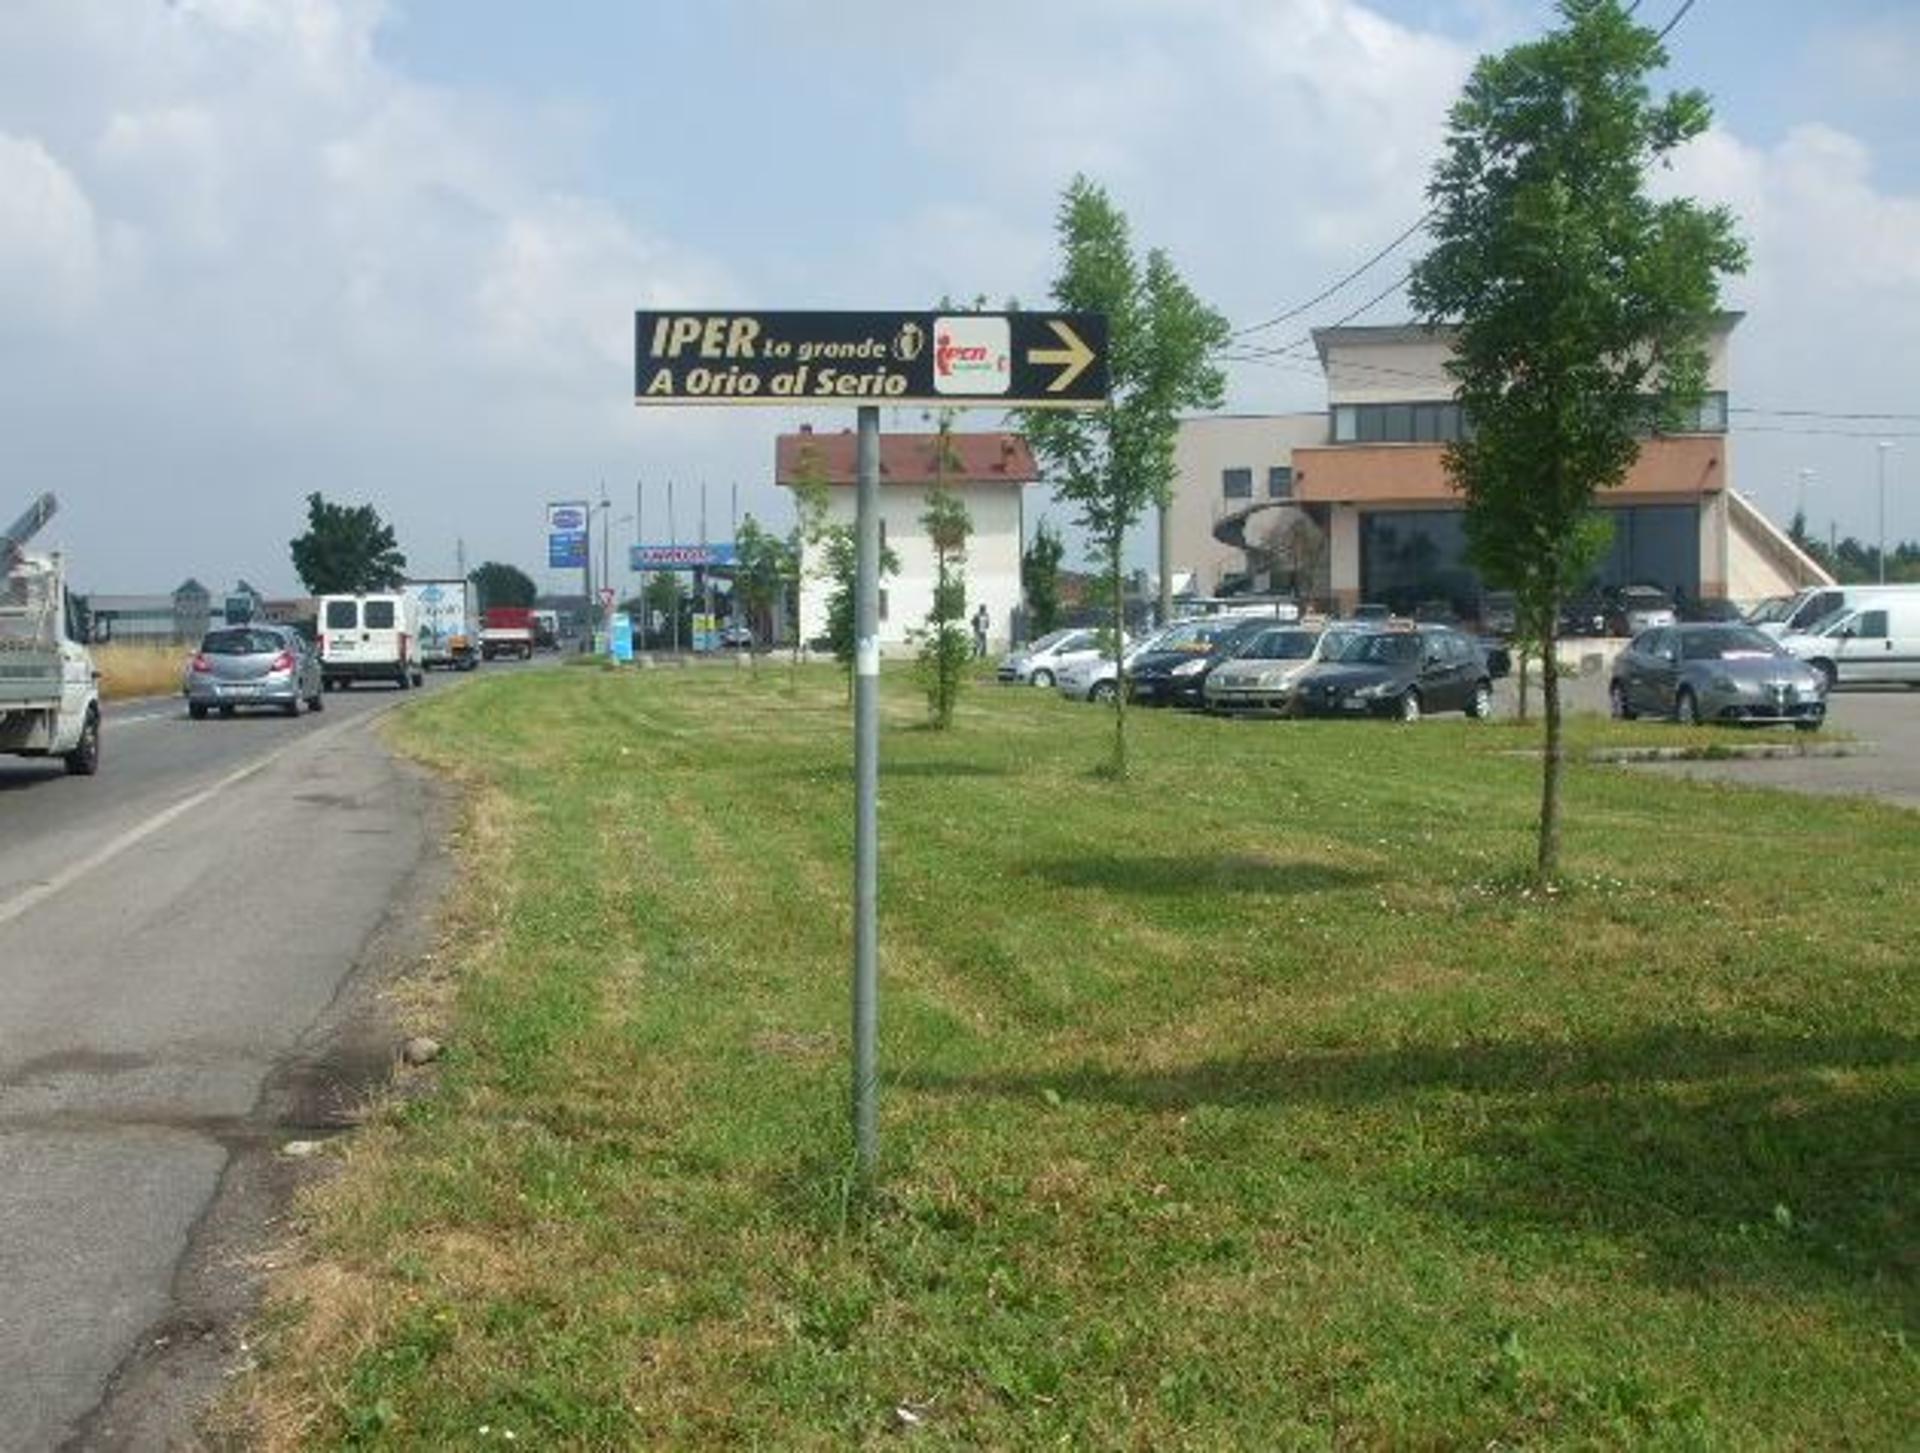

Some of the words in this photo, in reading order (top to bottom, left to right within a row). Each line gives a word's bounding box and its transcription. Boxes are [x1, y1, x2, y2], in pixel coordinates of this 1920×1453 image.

[650, 317, 760, 358] IPER
[797, 337, 886, 361] grande
[645, 368, 673, 394] A
[686, 366, 760, 394] Orio
[771, 366, 808, 394] al
[814, 366, 907, 394] Serio
